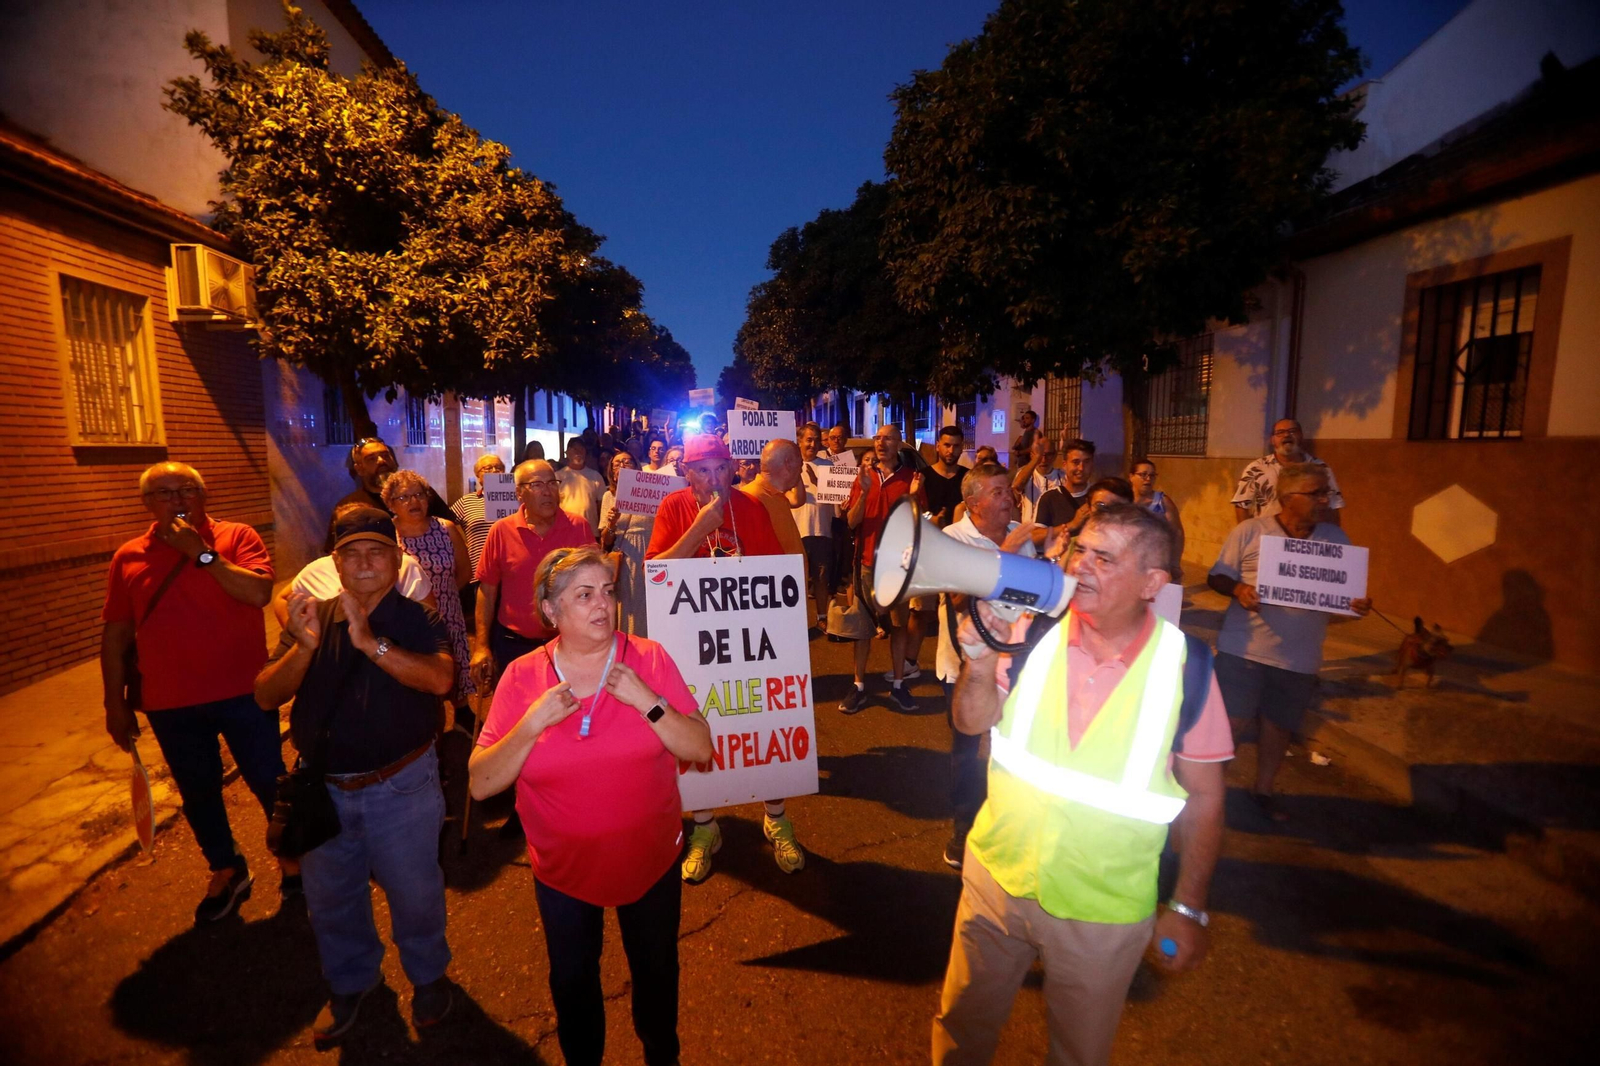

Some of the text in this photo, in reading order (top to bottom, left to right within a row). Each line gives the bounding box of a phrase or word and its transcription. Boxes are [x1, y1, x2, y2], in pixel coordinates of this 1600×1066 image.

[742, 410, 778, 426] PODA DE
[732, 440, 770, 456] ARBOLE
[636, 472, 670, 486] QUEREMOS
[827, 478, 836, 488] MÁS
[630, 486, 660, 500] MEJORAS
[1284, 539, 1343, 558] NECESITAMOS
[1278, 560, 1347, 584] MÁS SEGURIDAD
[669, 574, 800, 615] ARREGLO
[1258, 584, 1351, 610] EN NUESTRAS CALLES
[699, 628, 777, 665] DE LA
[687, 674, 808, 718] ALLE REY
[728, 726, 810, 770] PELAYO
